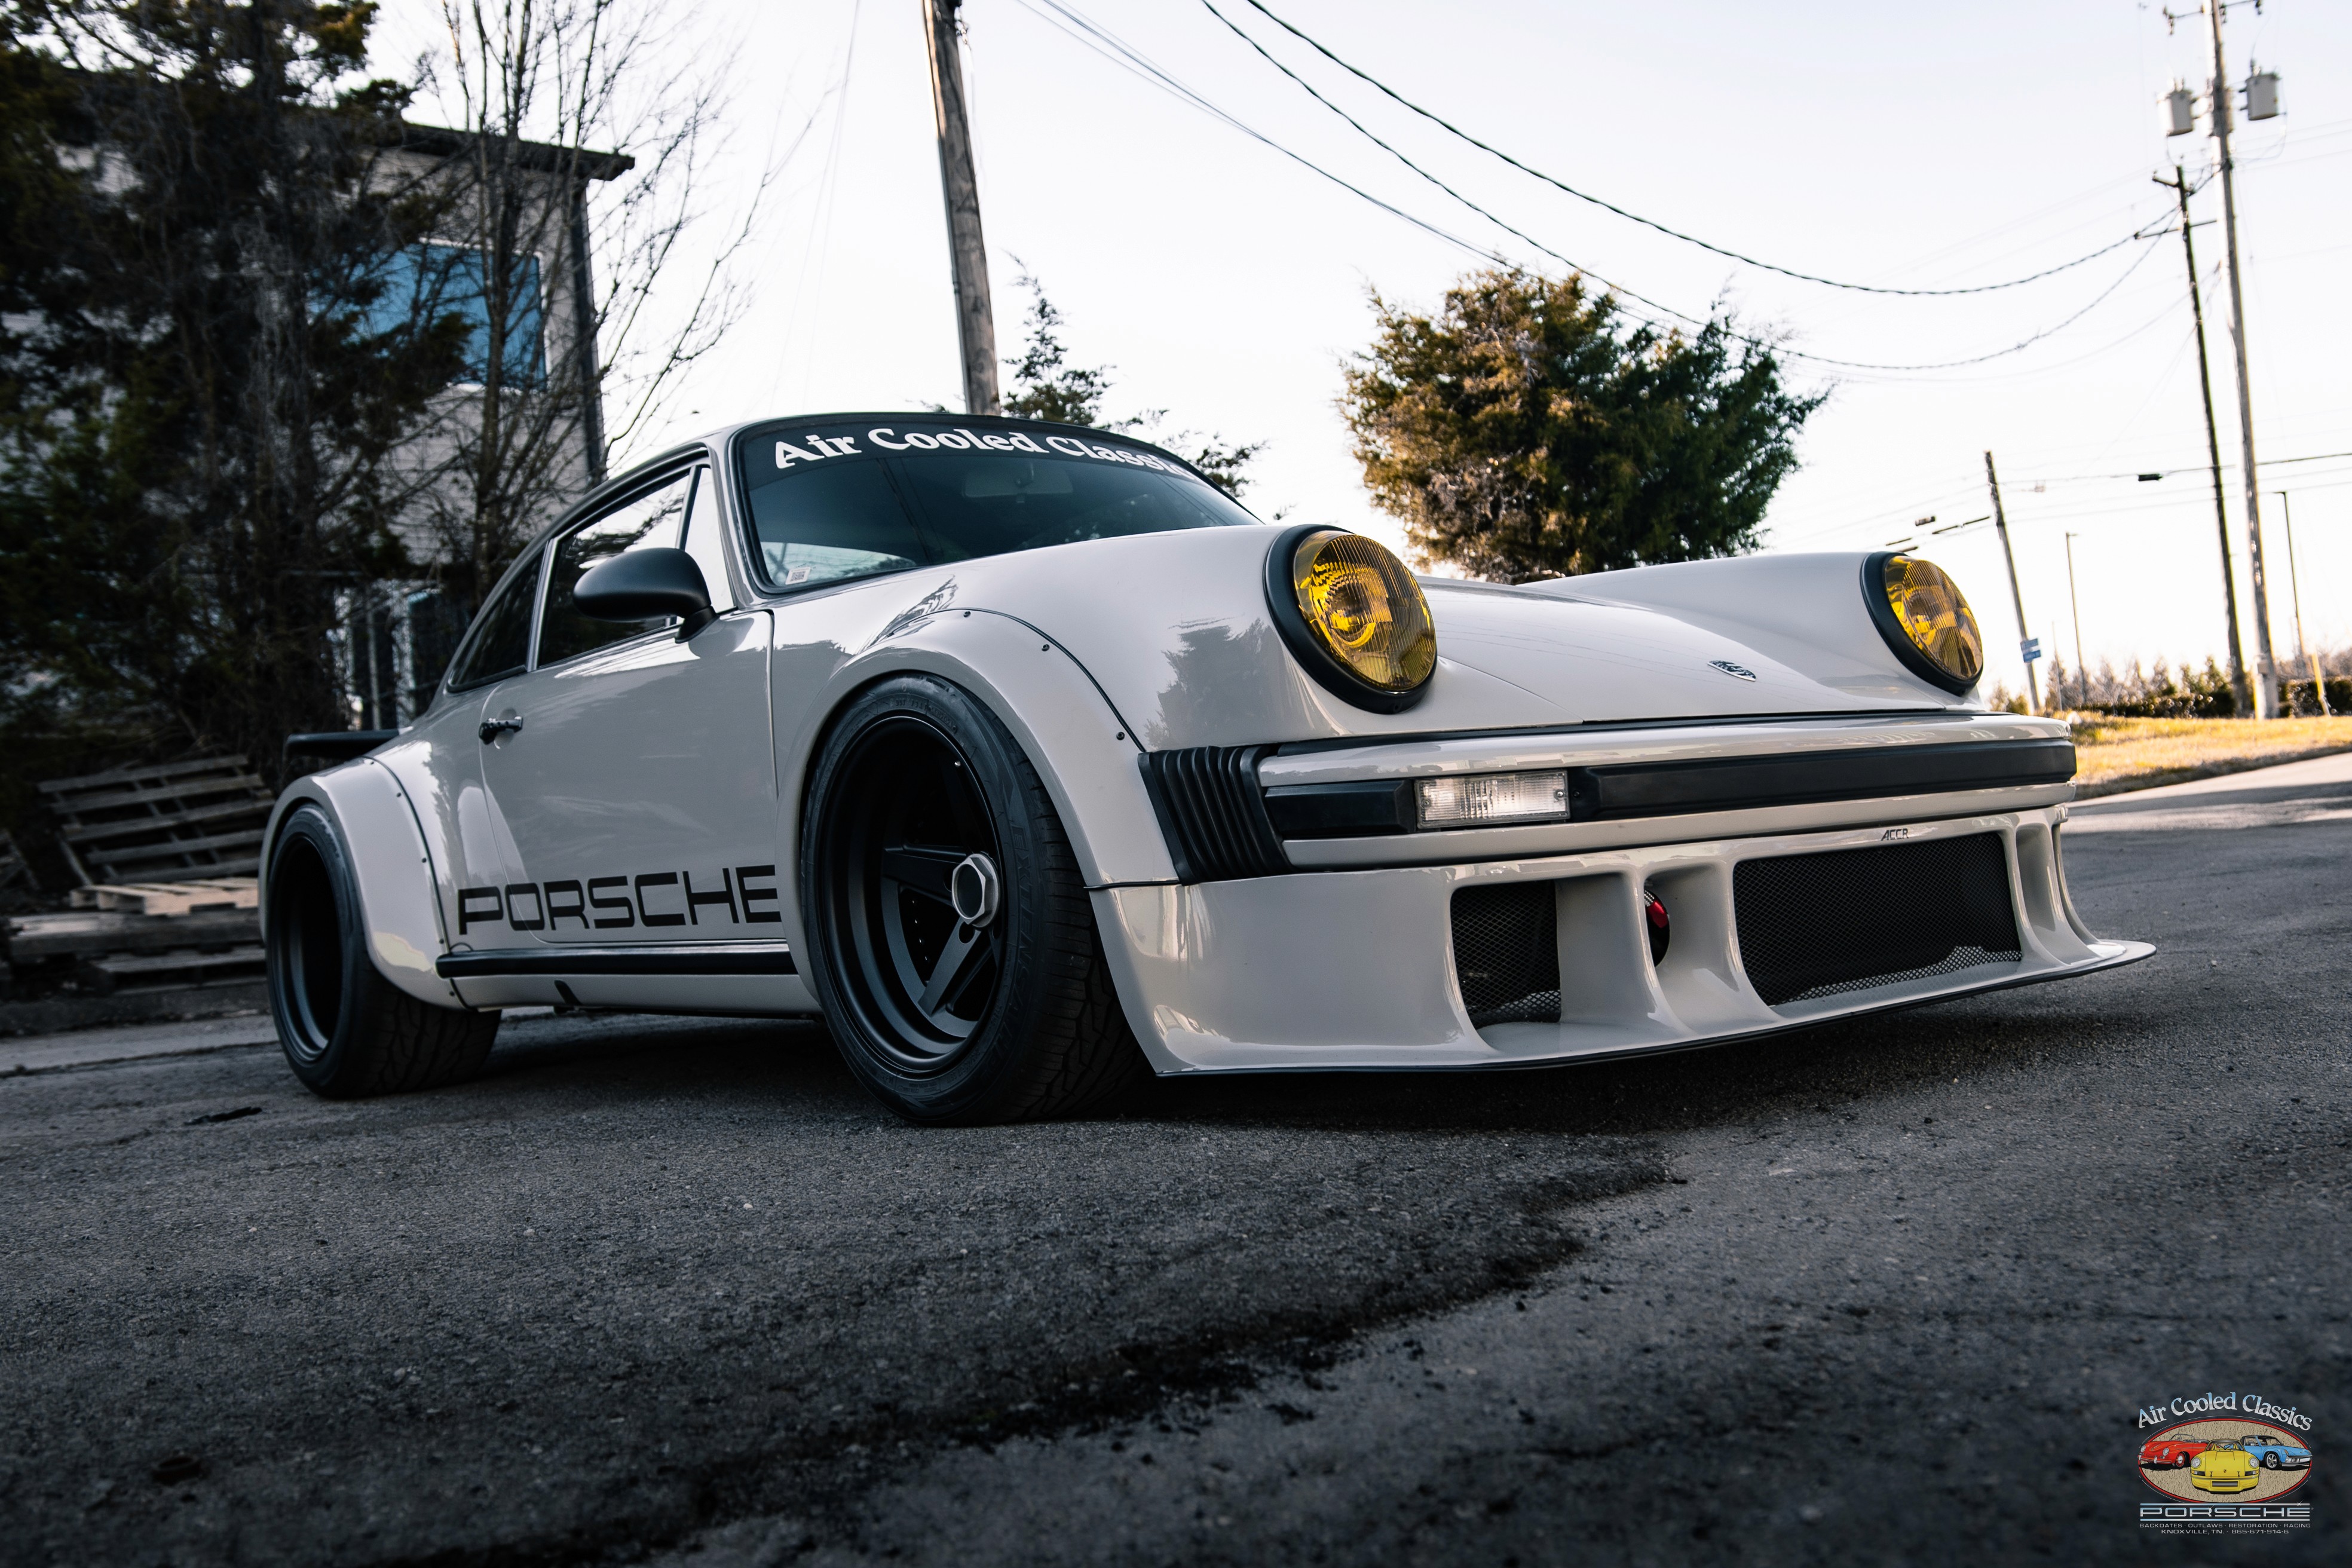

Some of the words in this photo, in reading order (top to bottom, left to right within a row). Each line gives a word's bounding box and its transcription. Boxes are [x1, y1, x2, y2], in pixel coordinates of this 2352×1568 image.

[775, 434, 862, 469] Air
[868, 428, 1049, 453] Cooled
[1045, 436, 1195, 480] Classic
[1881, 828, 1909, 841] ACCR
[458, 864, 782, 936] PORSCHE
